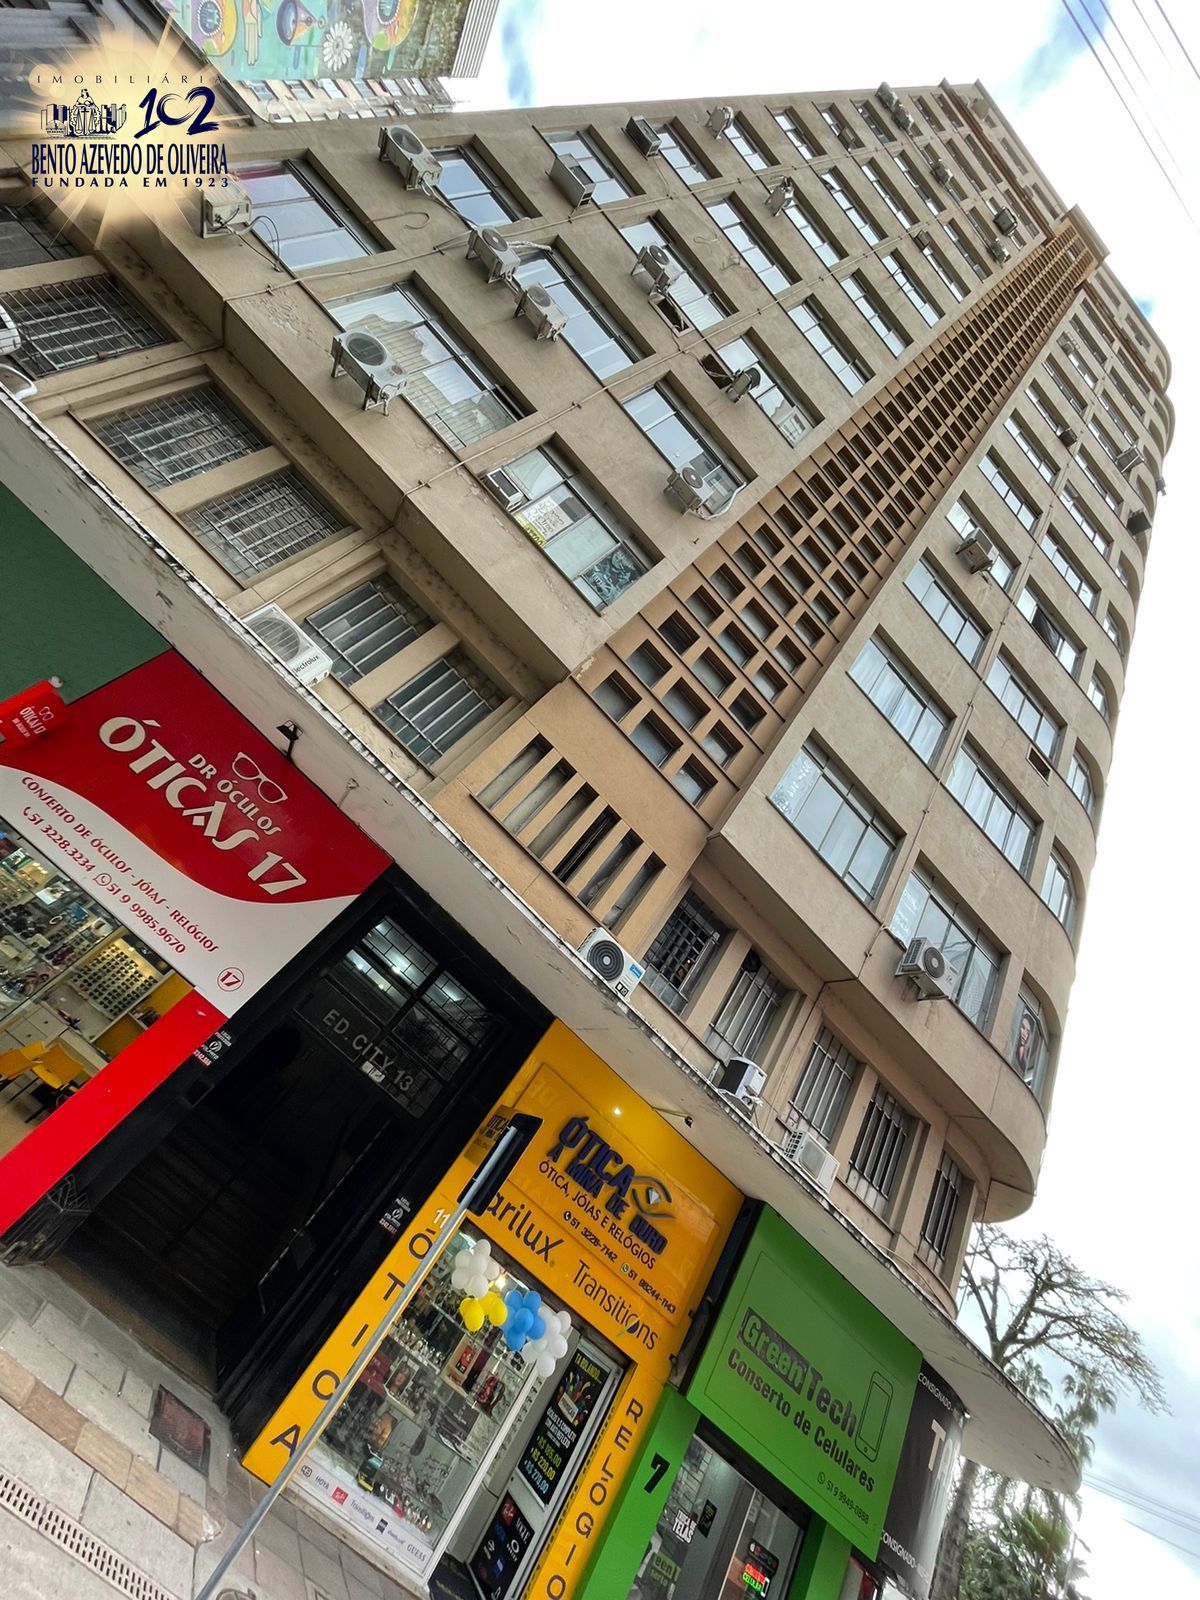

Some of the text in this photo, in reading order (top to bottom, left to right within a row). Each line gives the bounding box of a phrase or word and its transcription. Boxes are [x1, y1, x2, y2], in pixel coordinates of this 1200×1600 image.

[99, 716, 307, 895] ÓTICAS 17
[188, 753, 281, 836] DR ÓCULOS
[22, 776, 75, 824] CONSERTO
[73, 823, 93, 838] DE
[90, 838, 132, 874] ÓCULOS
[132, 879, 166, 905] JÓIAS
[169, 910, 219, 952] RELÓGIOS
[28, 813, 186, 954] 51 3228.3234 51 9 9985.9670
[220, 970, 241, 987] 17
[323, 1009, 414, 1091] ED. CITY 13
[559, 1116, 635, 1198] ÓTICA
[433, 1208, 451, 1229] 11
[539, 1159, 656, 1270] ÓTICA, JÓIAS E RELÓGIOS
[546, 1143, 668, 1255] A MINA DE OURO
[487, 1191, 660, 1350] arilux Transitions
[570, 1217, 580, 1229] 51
[627, 1269, 638, 1280] 51
[727, 1348, 875, 1494] Conserto de Celulares
[918, 1372, 953, 1411] CONSIGNADO
[644, 1452, 671, 1494] 7
[407, 1543, 427, 1562] GUESS
[672, 1518, 694, 1543] TELAS
